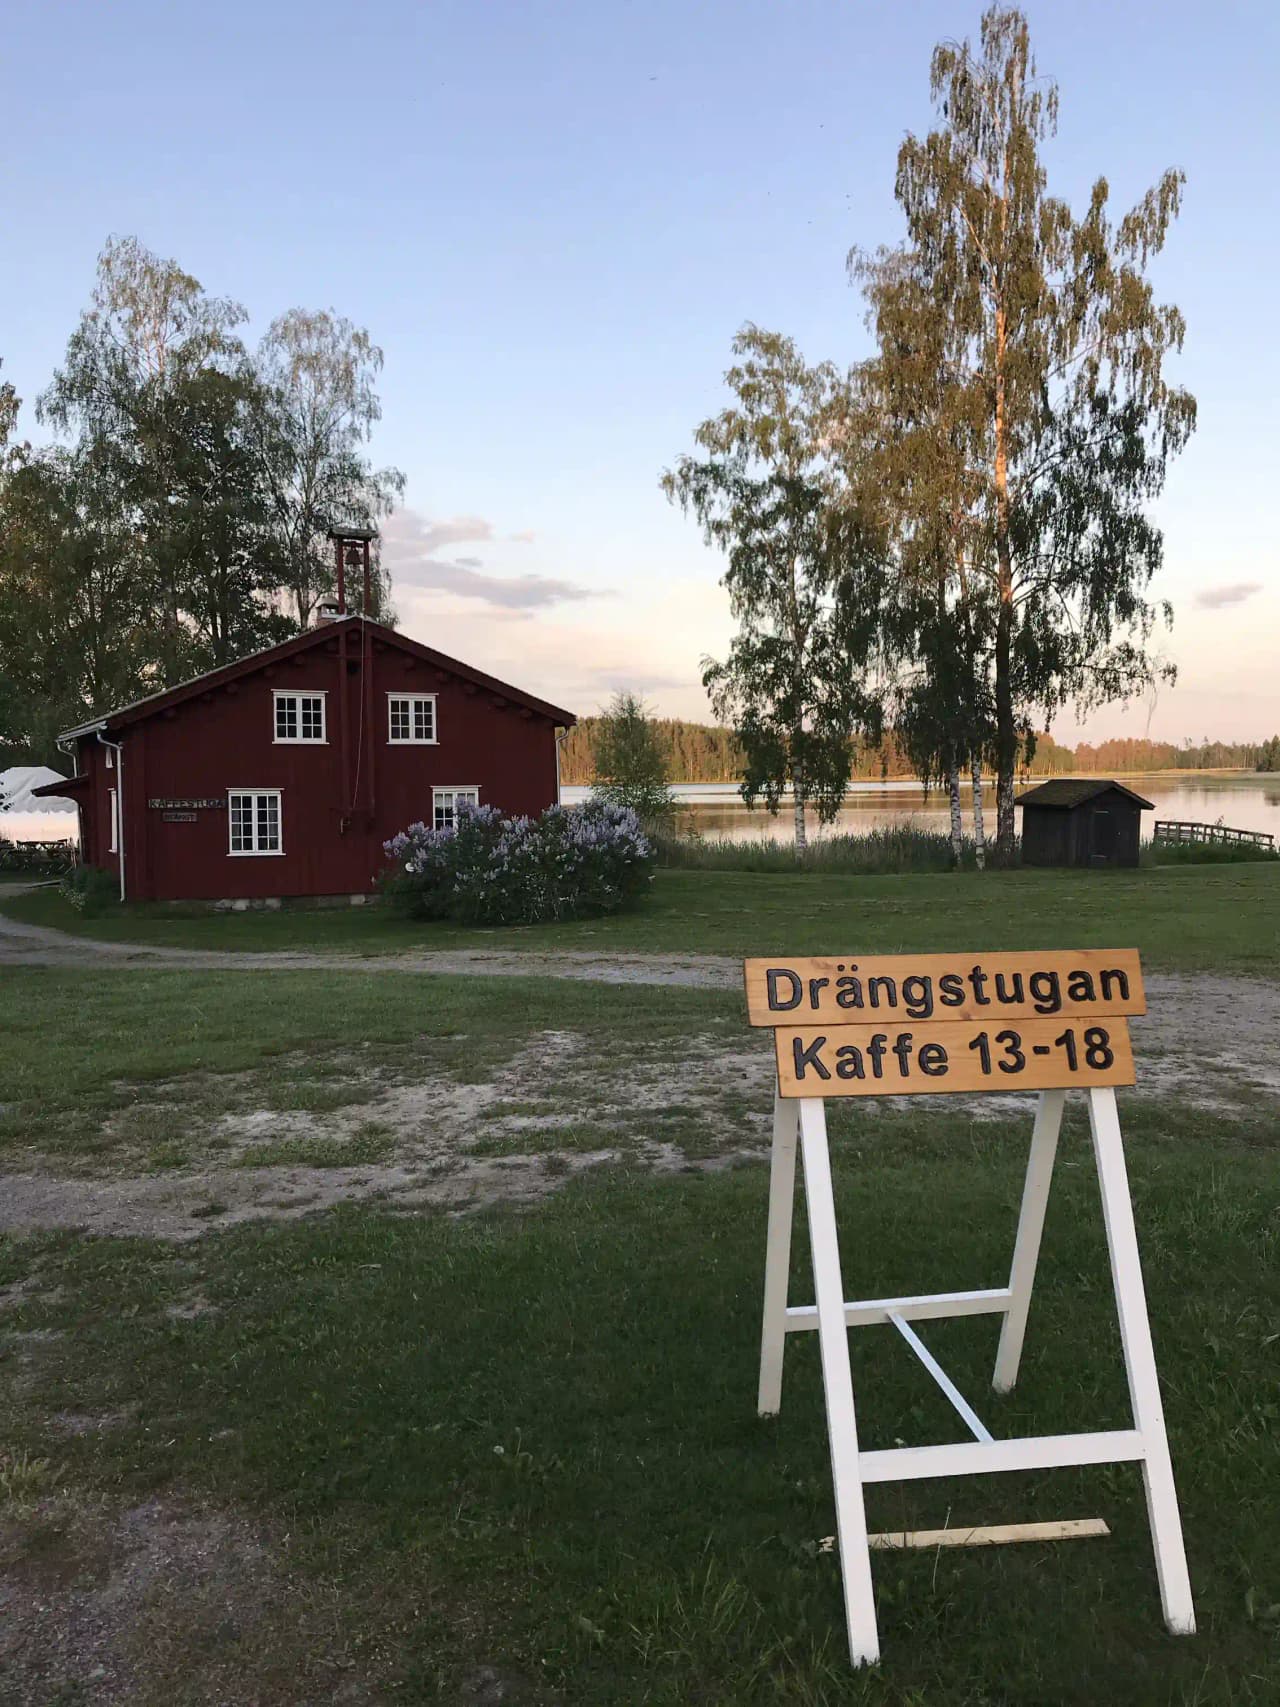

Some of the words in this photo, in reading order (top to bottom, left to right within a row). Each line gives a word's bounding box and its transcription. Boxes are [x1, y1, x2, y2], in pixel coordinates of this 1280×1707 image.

[766, 964, 1130, 1018] Drängstugan
[793, 1032, 949, 1080] Kaffe
[968, 1027, 1114, 1075] 13-18
